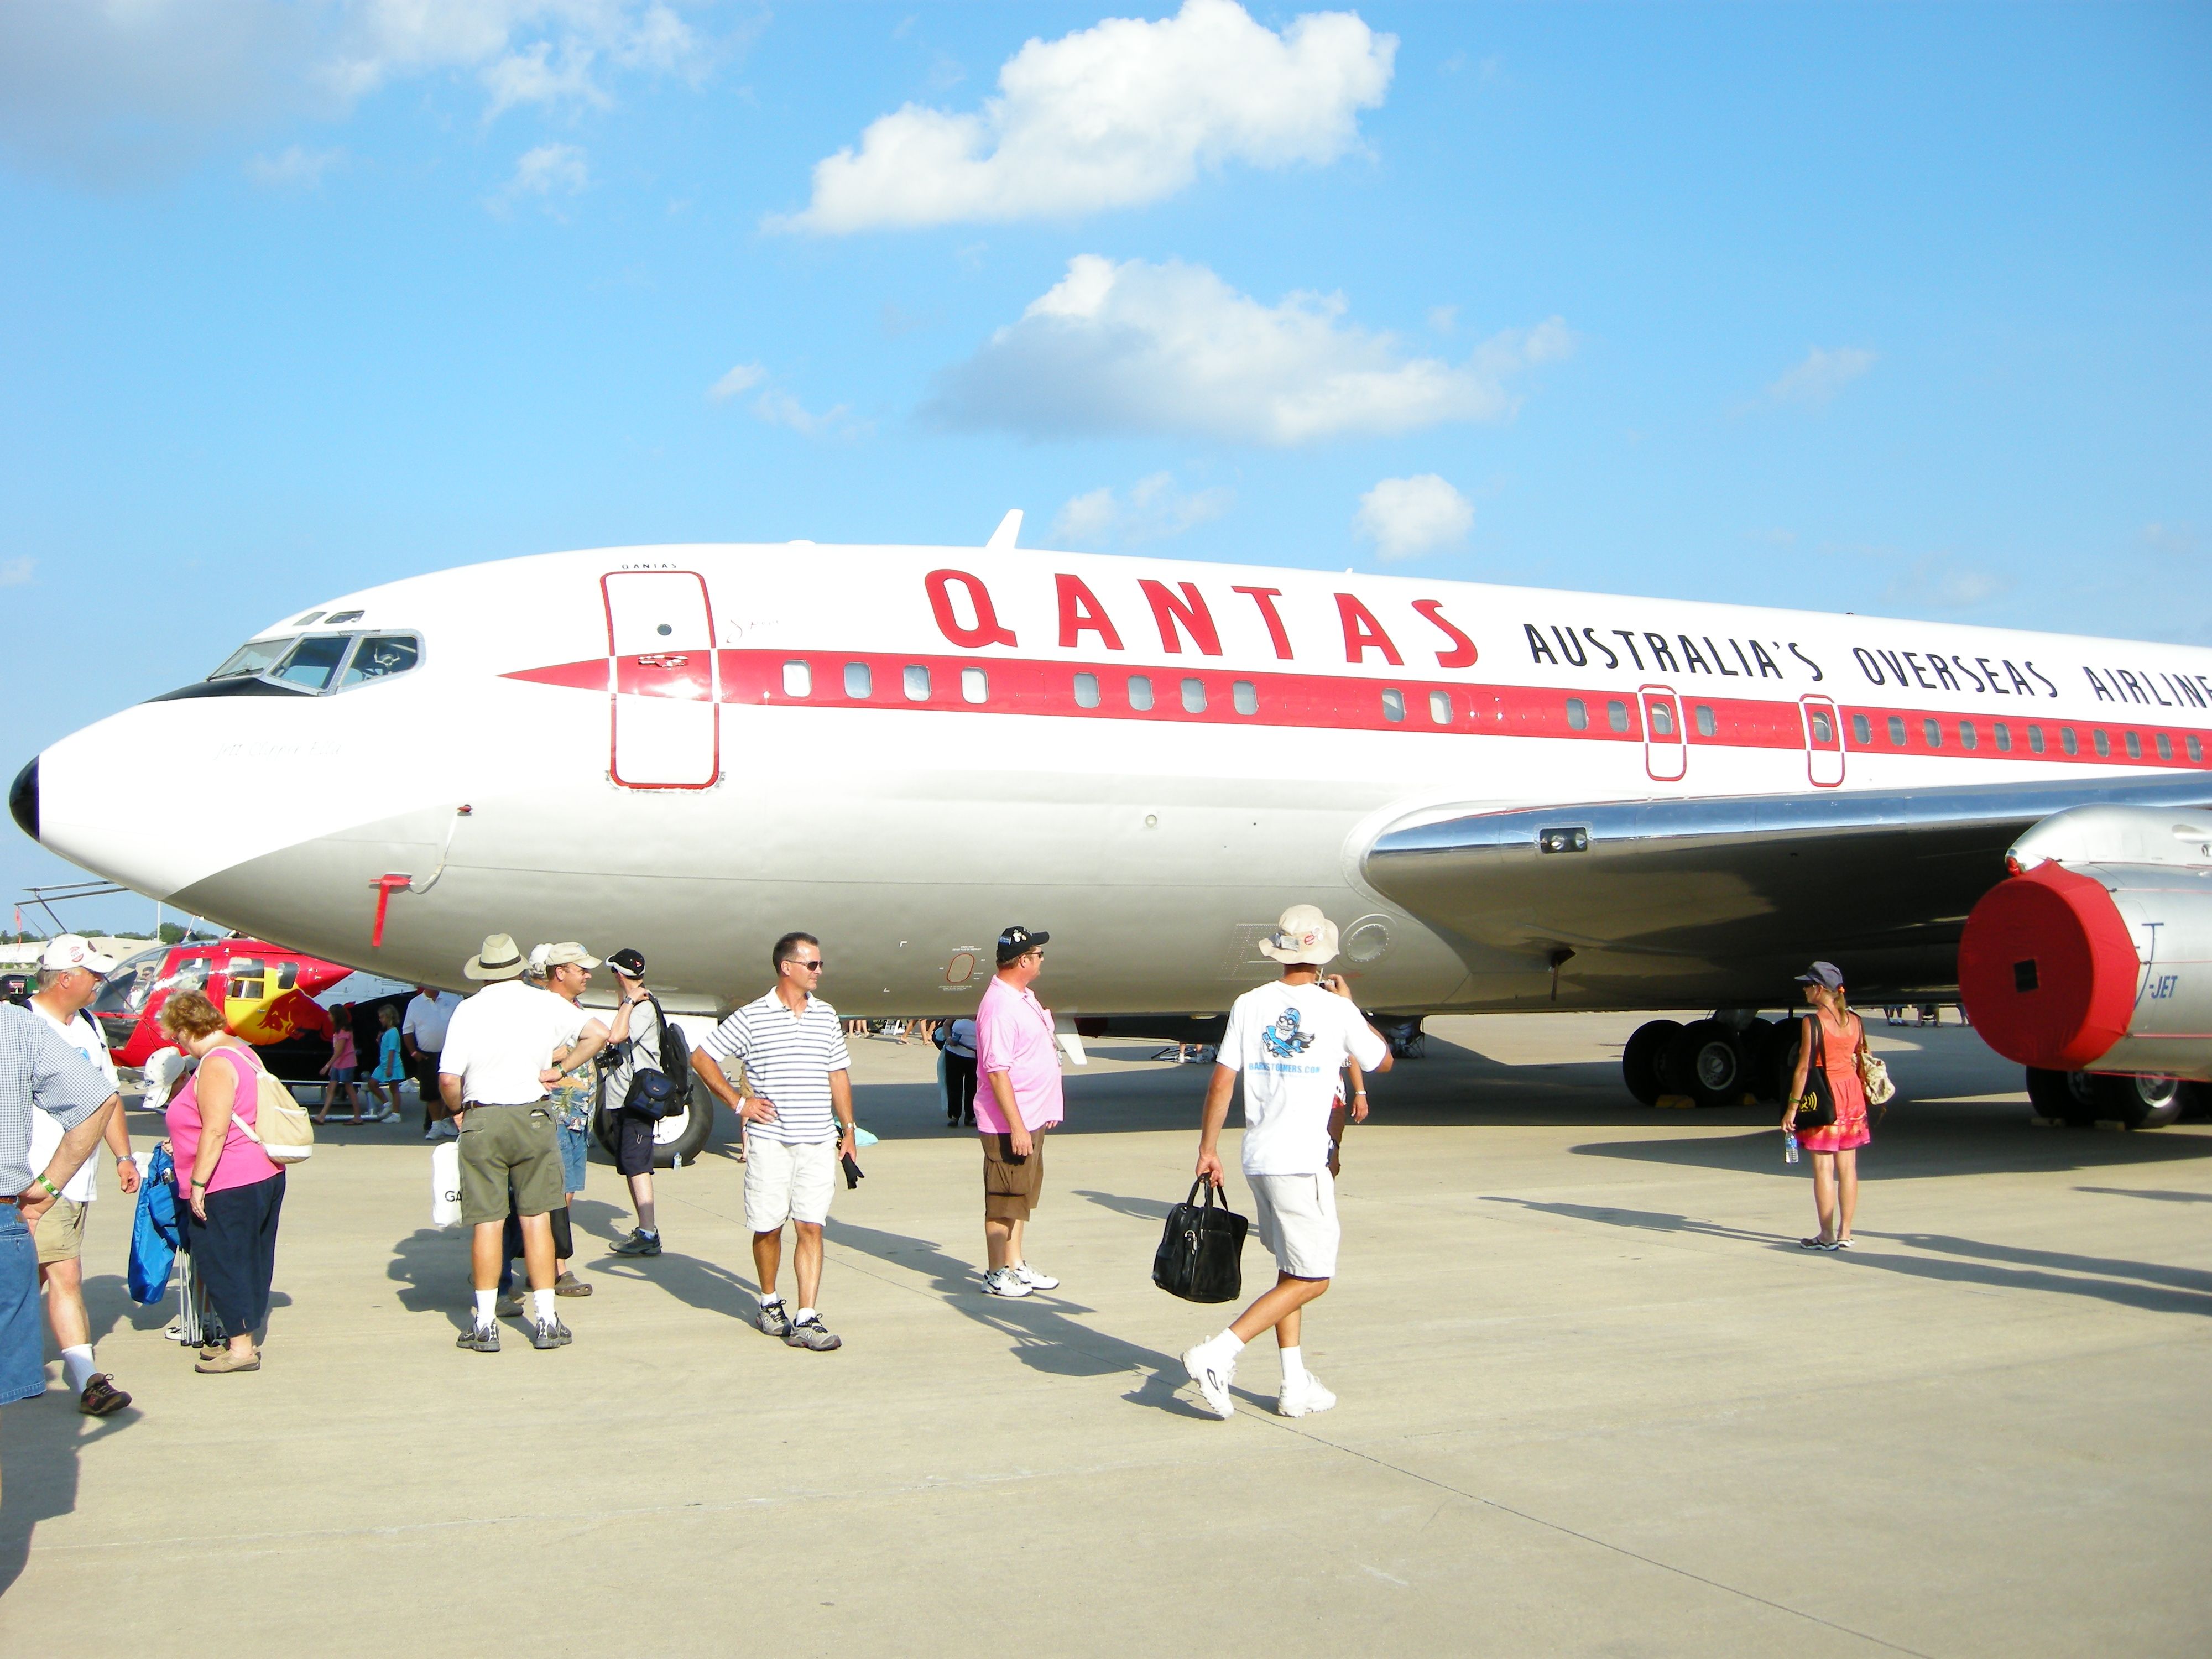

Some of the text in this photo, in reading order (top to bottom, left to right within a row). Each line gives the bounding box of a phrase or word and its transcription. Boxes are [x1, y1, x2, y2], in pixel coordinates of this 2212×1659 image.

[925, 570, 1477, 667] QANTAS
[1524, 624, 1823, 682] AUSTRALIA'S
[1853, 648, 2058, 698] OVERSEAS
